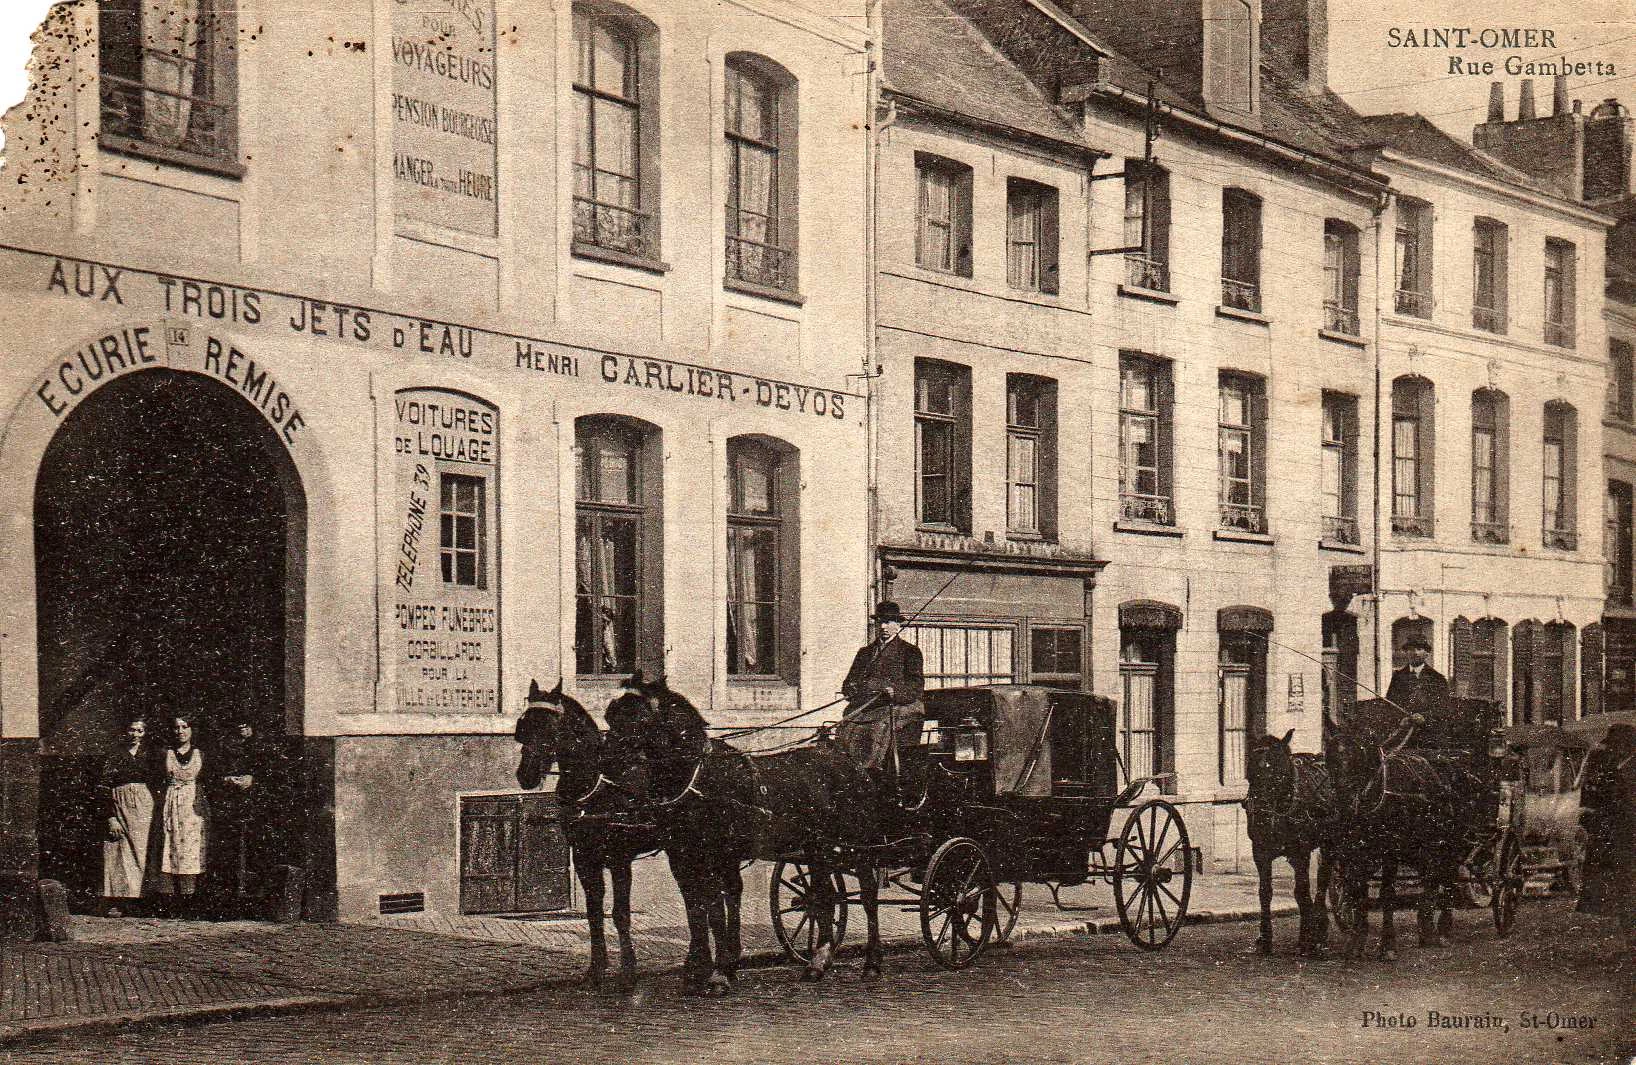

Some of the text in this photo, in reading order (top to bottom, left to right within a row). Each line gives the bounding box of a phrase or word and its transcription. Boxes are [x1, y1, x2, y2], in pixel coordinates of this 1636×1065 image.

[391, 36, 492, 90] VOYAGEURS
[459, 169, 492, 201] HEURE
[47, 259, 125, 304] AUX
[158, 276, 262, 325] TROIS
[289, 301, 372, 342] JETS
[515, 341, 580, 377] HENRI
[37, 326, 305, 446] ECURIE REMISE
[395, 399, 492, 435] VOITURES
[395, 432, 491, 462] DE LOUAGE
[396, 491, 426, 593] TELEPHONE
[396, 603, 436, 631] POMPES
[422, 667, 468, 681] POUR LA
